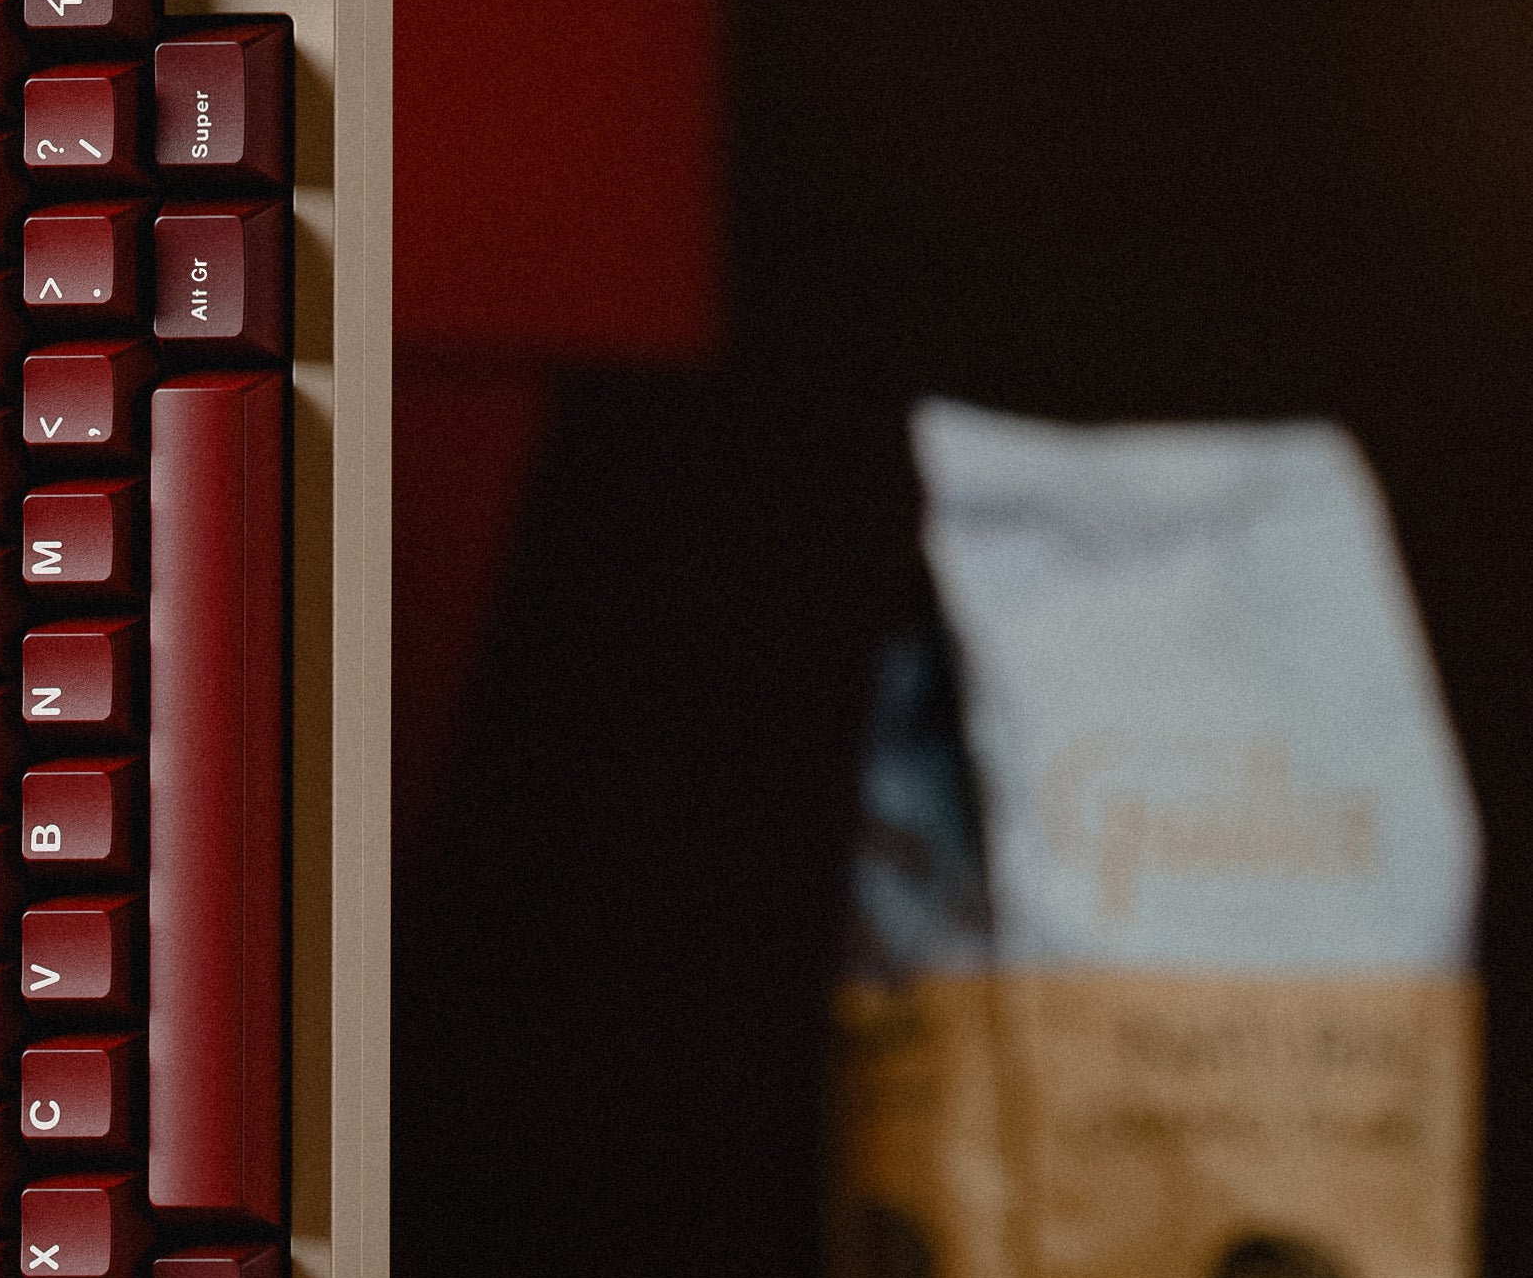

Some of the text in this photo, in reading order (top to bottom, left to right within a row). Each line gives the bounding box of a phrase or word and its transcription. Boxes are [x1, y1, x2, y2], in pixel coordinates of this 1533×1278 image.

[191, 90, 212, 158] Super
[36, 139, 65, 160] ?
[39, 277, 63, 300] >
[190, 257, 208, 321] Alt Gr
[39, 416, 63, 439] <
[31, 541, 63, 575] M
[30, 687, 62, 716] N
[30, 824, 61, 852] B
[29, 964, 61, 992] V
[29, 1100, 61, 1131] C
[28, 1244, 60, 1271] X
